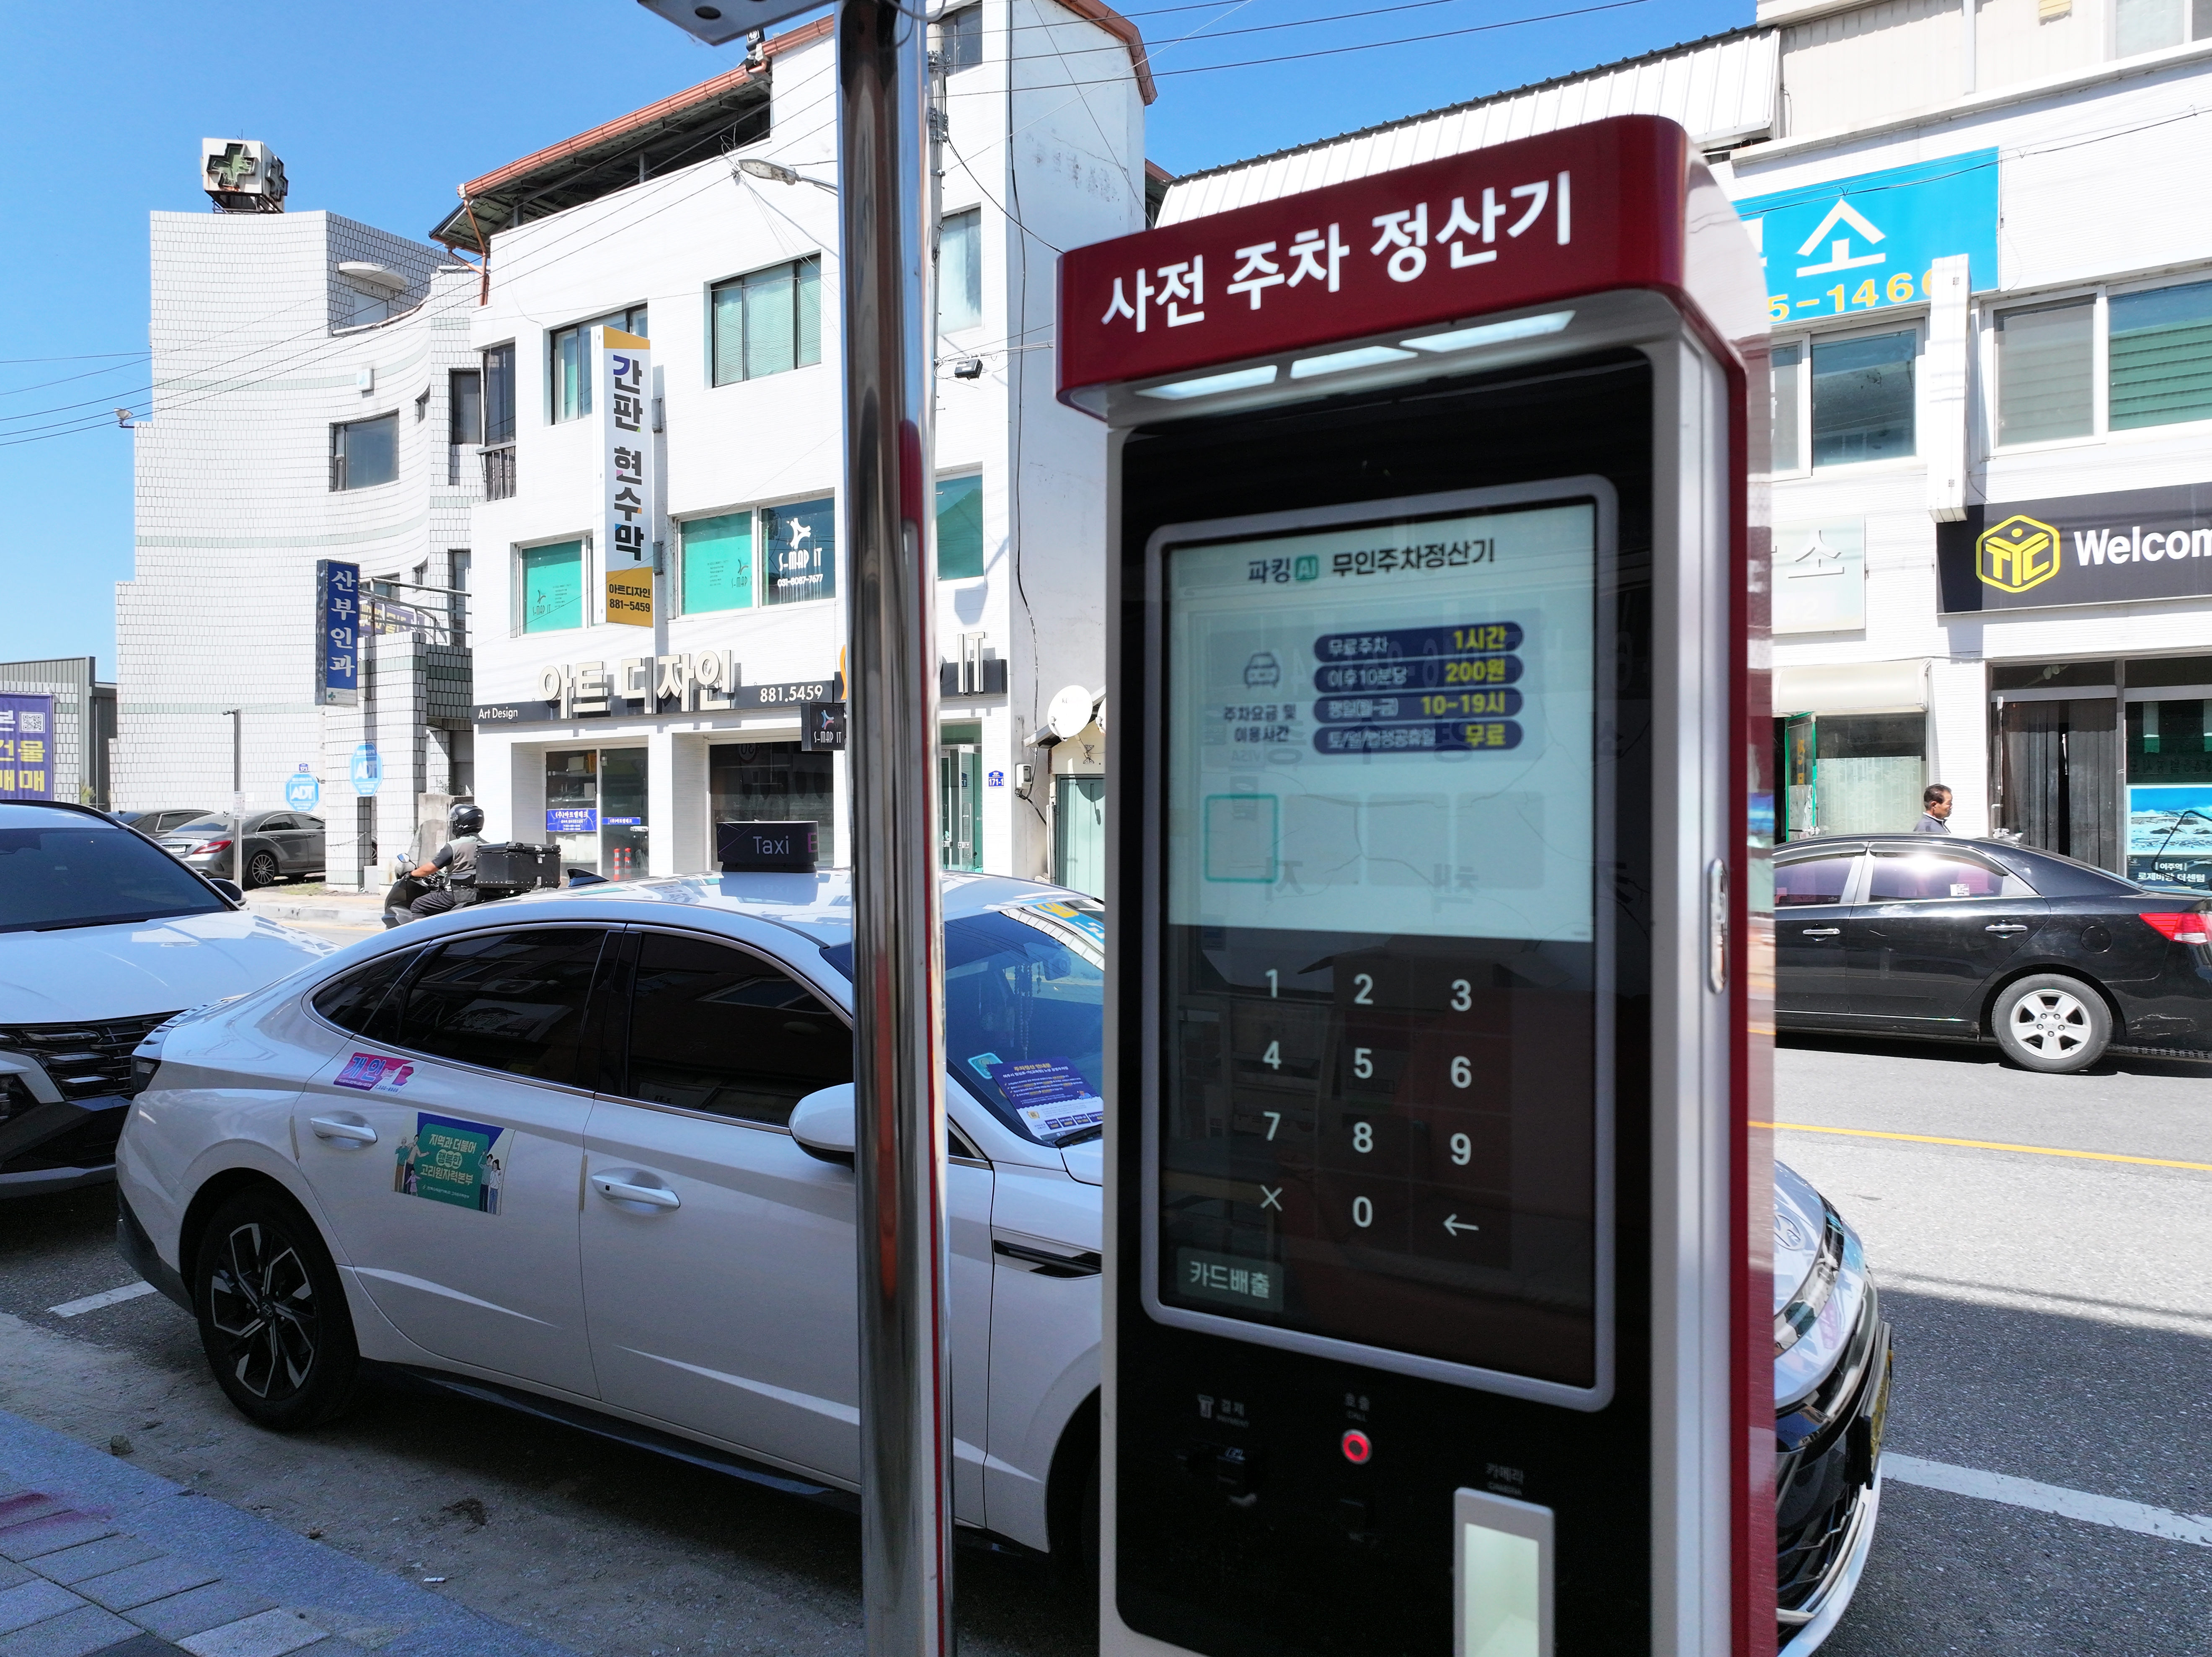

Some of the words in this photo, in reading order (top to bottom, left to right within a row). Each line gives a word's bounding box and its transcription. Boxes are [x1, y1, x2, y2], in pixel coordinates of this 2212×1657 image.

[1101, 254, 1205, 333] 사전
[1227, 222, 1350, 310] 주차
[1370, 170, 1571, 282] 정산기
[613, 354, 643, 433] 간판
[614, 446, 645, 562] 현수막
[779, 550, 810, 571] S-MAP
[1332, 538, 1495, 576] 무인주차정산기
[609, 583, 651, 599] 아트디자인
[777, 574, 823, 588] 031-8087-7677
[609, 599, 650, 612] 881-5459
[329, 570, 357, 678] 산부인과
[1328, 635, 1389, 656] 무료주차
[1454, 626, 1507, 650] 1시간
[1445, 658, 1506, 684] 200원
[539, 661, 608, 719] 아트
[622, 650, 735, 714] 디자인
[760, 684, 823, 702] 881.5459
[478, 708, 491, 719] Art
[492, 707, 518, 720] Design
[814, 730, 834, 743] S-MAP
[836, 731, 842, 743] IT
[1466, 723, 1506, 747] 무료
[355, 760, 377, 779] ADT
[290, 785, 315, 800] ADT
[752, 835, 789, 855] Taxi
[1264, 968, 1278, 998] 1
[1353, 973, 1374, 1005] 2
[1450, 978, 1472, 1012] 3
[343, 1056, 386, 1082] 개인
[1262, 1040, 1282, 1071] 4
[1353, 1047, 1374, 1079] 5
[1450, 1056, 1472, 1089] 6
[429, 1133, 453, 1149] 지역과
[1263, 1111, 1282, 1141] 7
[1352, 1121, 1374, 1154] 8
[1450, 1132, 1472, 1165] 9
[438, 1152, 461, 1167] 행복한
[420, 1164, 473, 1186] 고리원자력본부
[1352, 1195, 1373, 1228] 0
[1189, 1260, 1269, 1299] 카드배출
